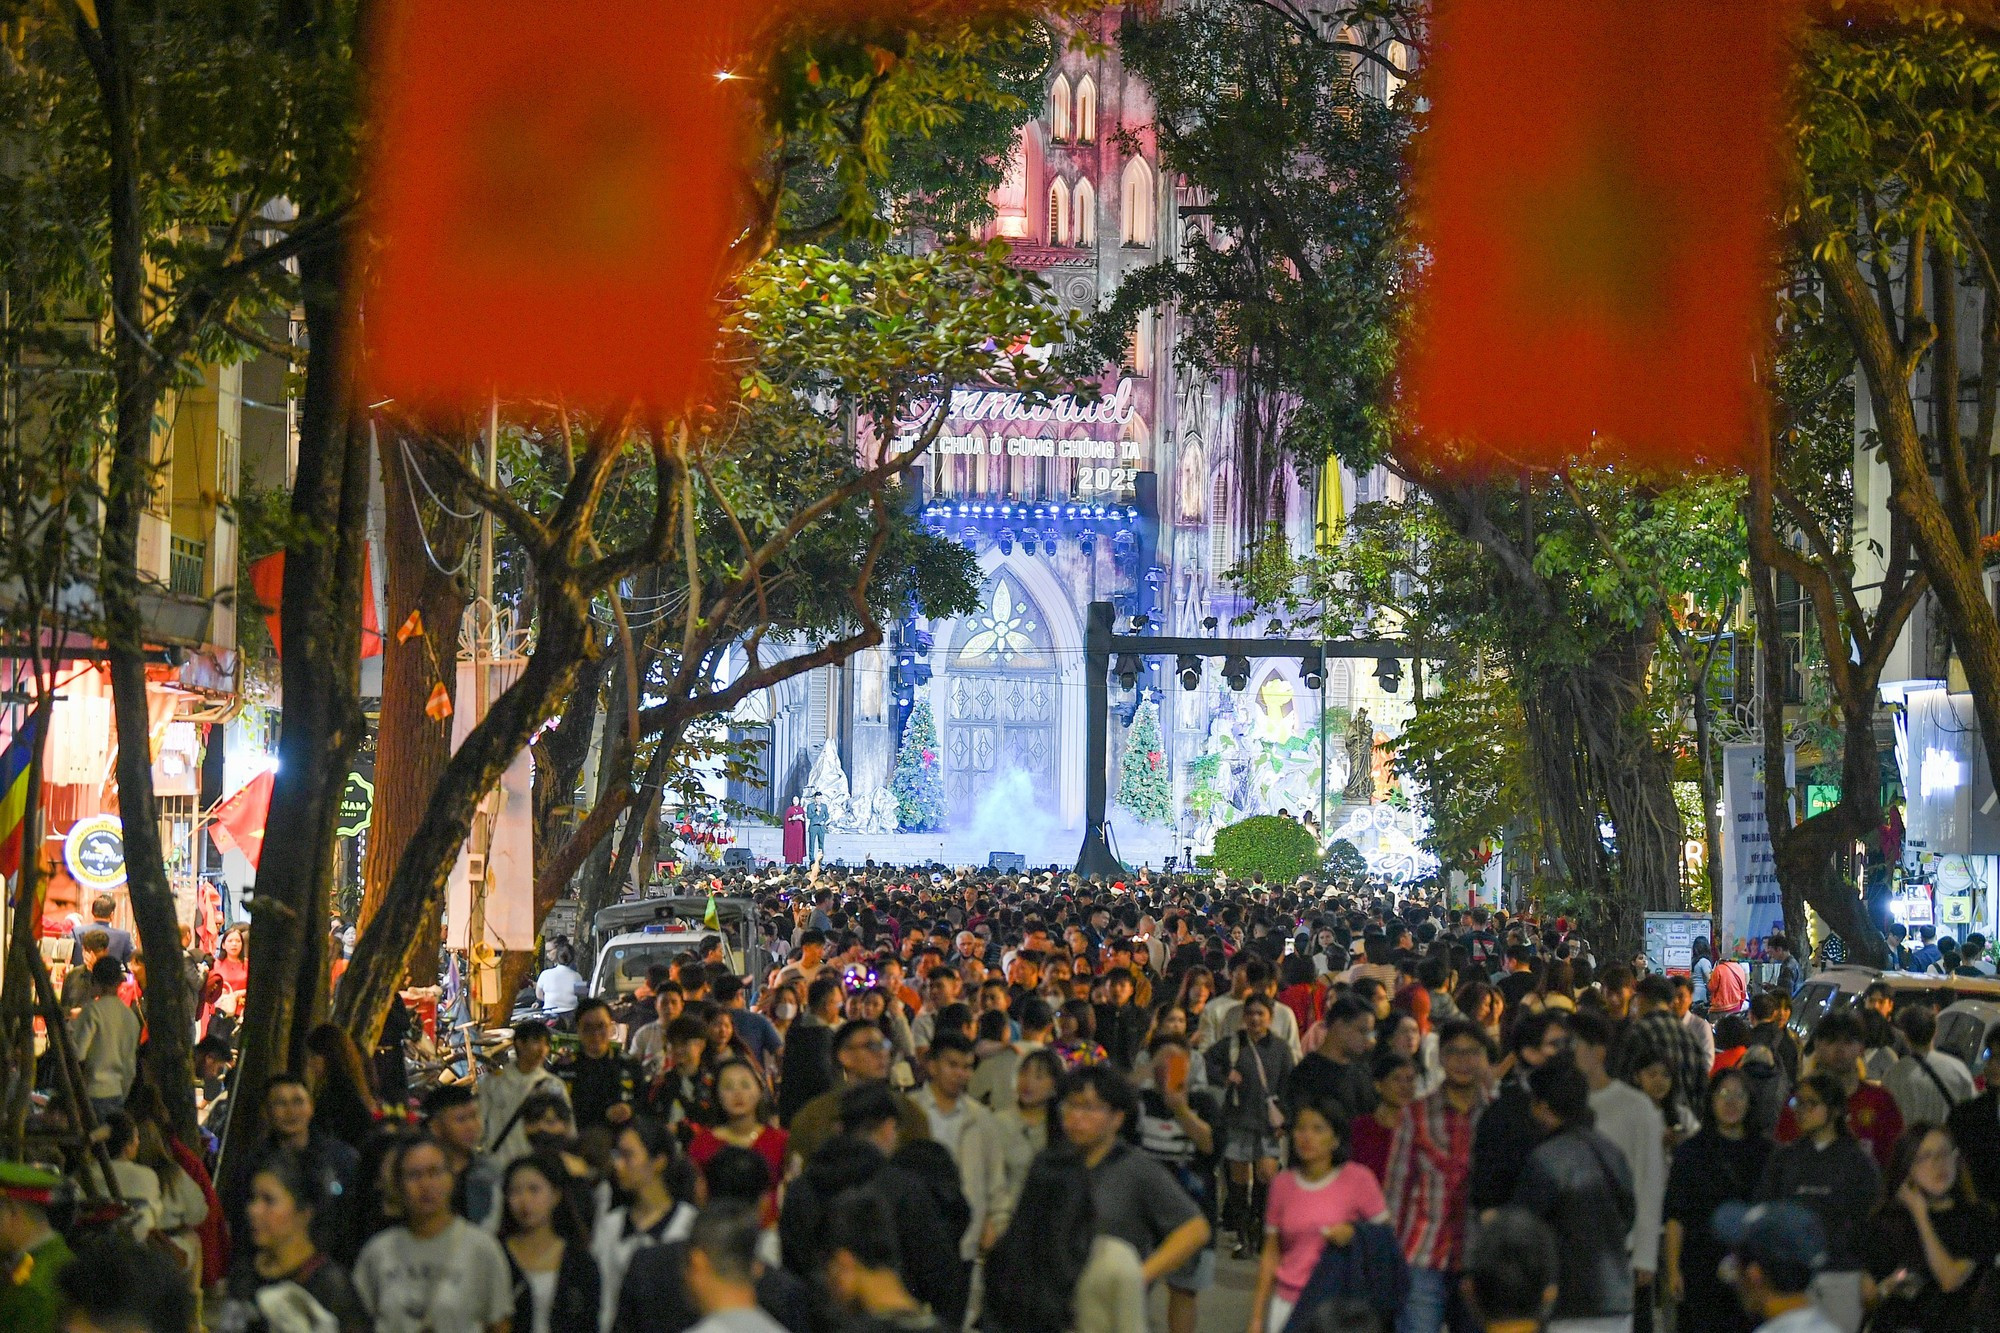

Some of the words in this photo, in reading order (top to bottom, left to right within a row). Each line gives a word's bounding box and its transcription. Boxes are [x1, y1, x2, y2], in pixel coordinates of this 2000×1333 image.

[940, 434, 985, 454] CHÚA
[990, 431, 1003, 455] Ở
[1007, 436, 1054, 457] CÙNG
[1059, 437, 1115, 459] CHÚNG
[1120, 441, 1141, 459] TA
